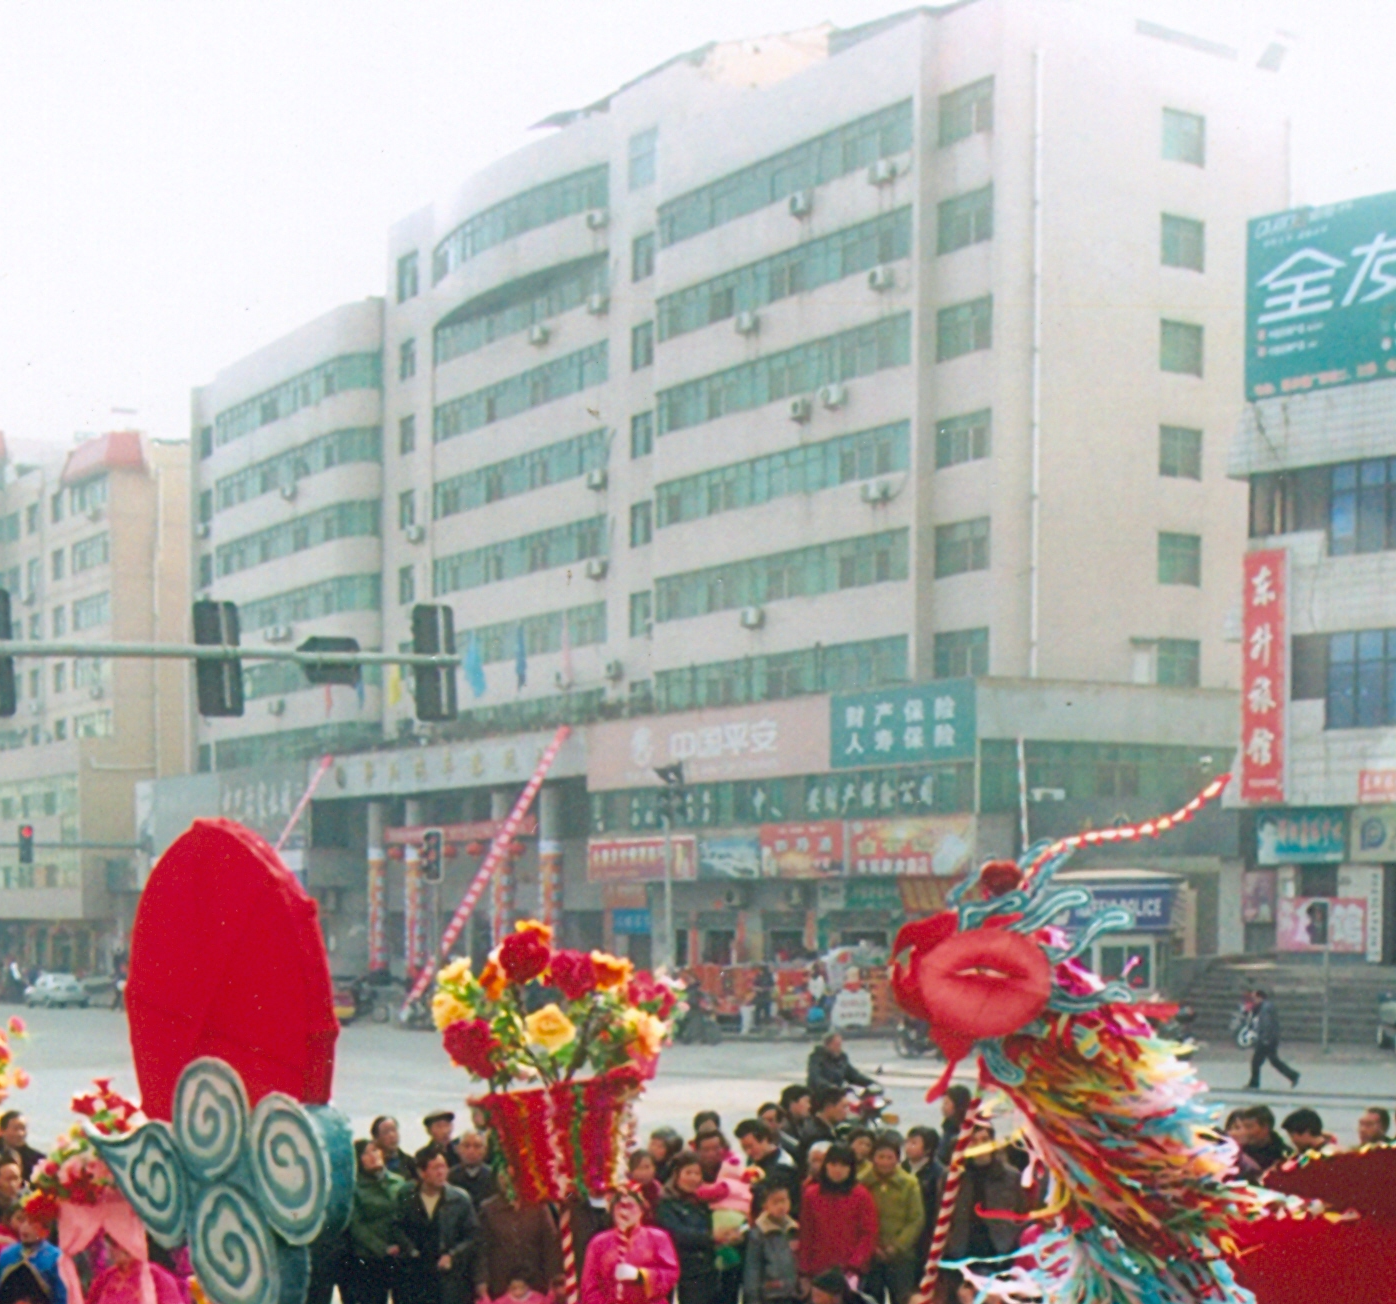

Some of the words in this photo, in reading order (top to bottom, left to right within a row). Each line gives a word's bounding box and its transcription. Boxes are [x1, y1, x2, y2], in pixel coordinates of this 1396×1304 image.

[1248, 564, 1278, 768] 东升旅馆
[845, 696, 955, 729] 财产保险
[669, 719, 778, 759] 中国平安
[845, 723, 955, 755] 人寿保险
